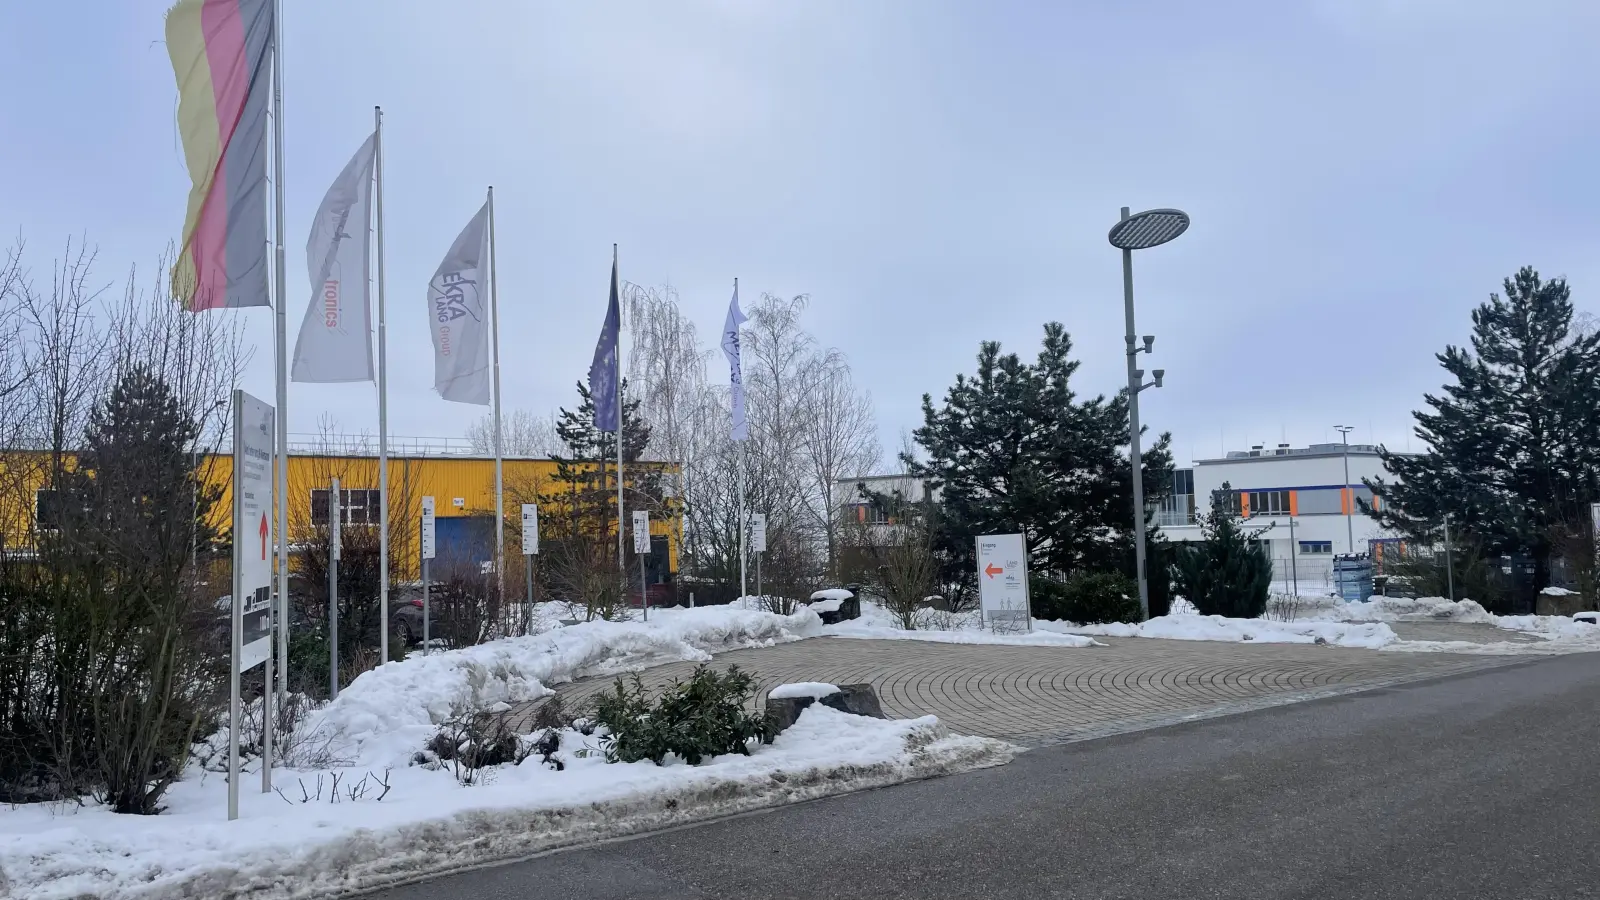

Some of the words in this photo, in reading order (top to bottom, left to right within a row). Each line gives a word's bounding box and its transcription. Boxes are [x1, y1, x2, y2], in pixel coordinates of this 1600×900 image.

[325, 280, 339, 327] tronics
[435, 296, 449, 323] LANG
[442, 272, 476, 320] EKRA
[440, 325, 451, 357] Group
